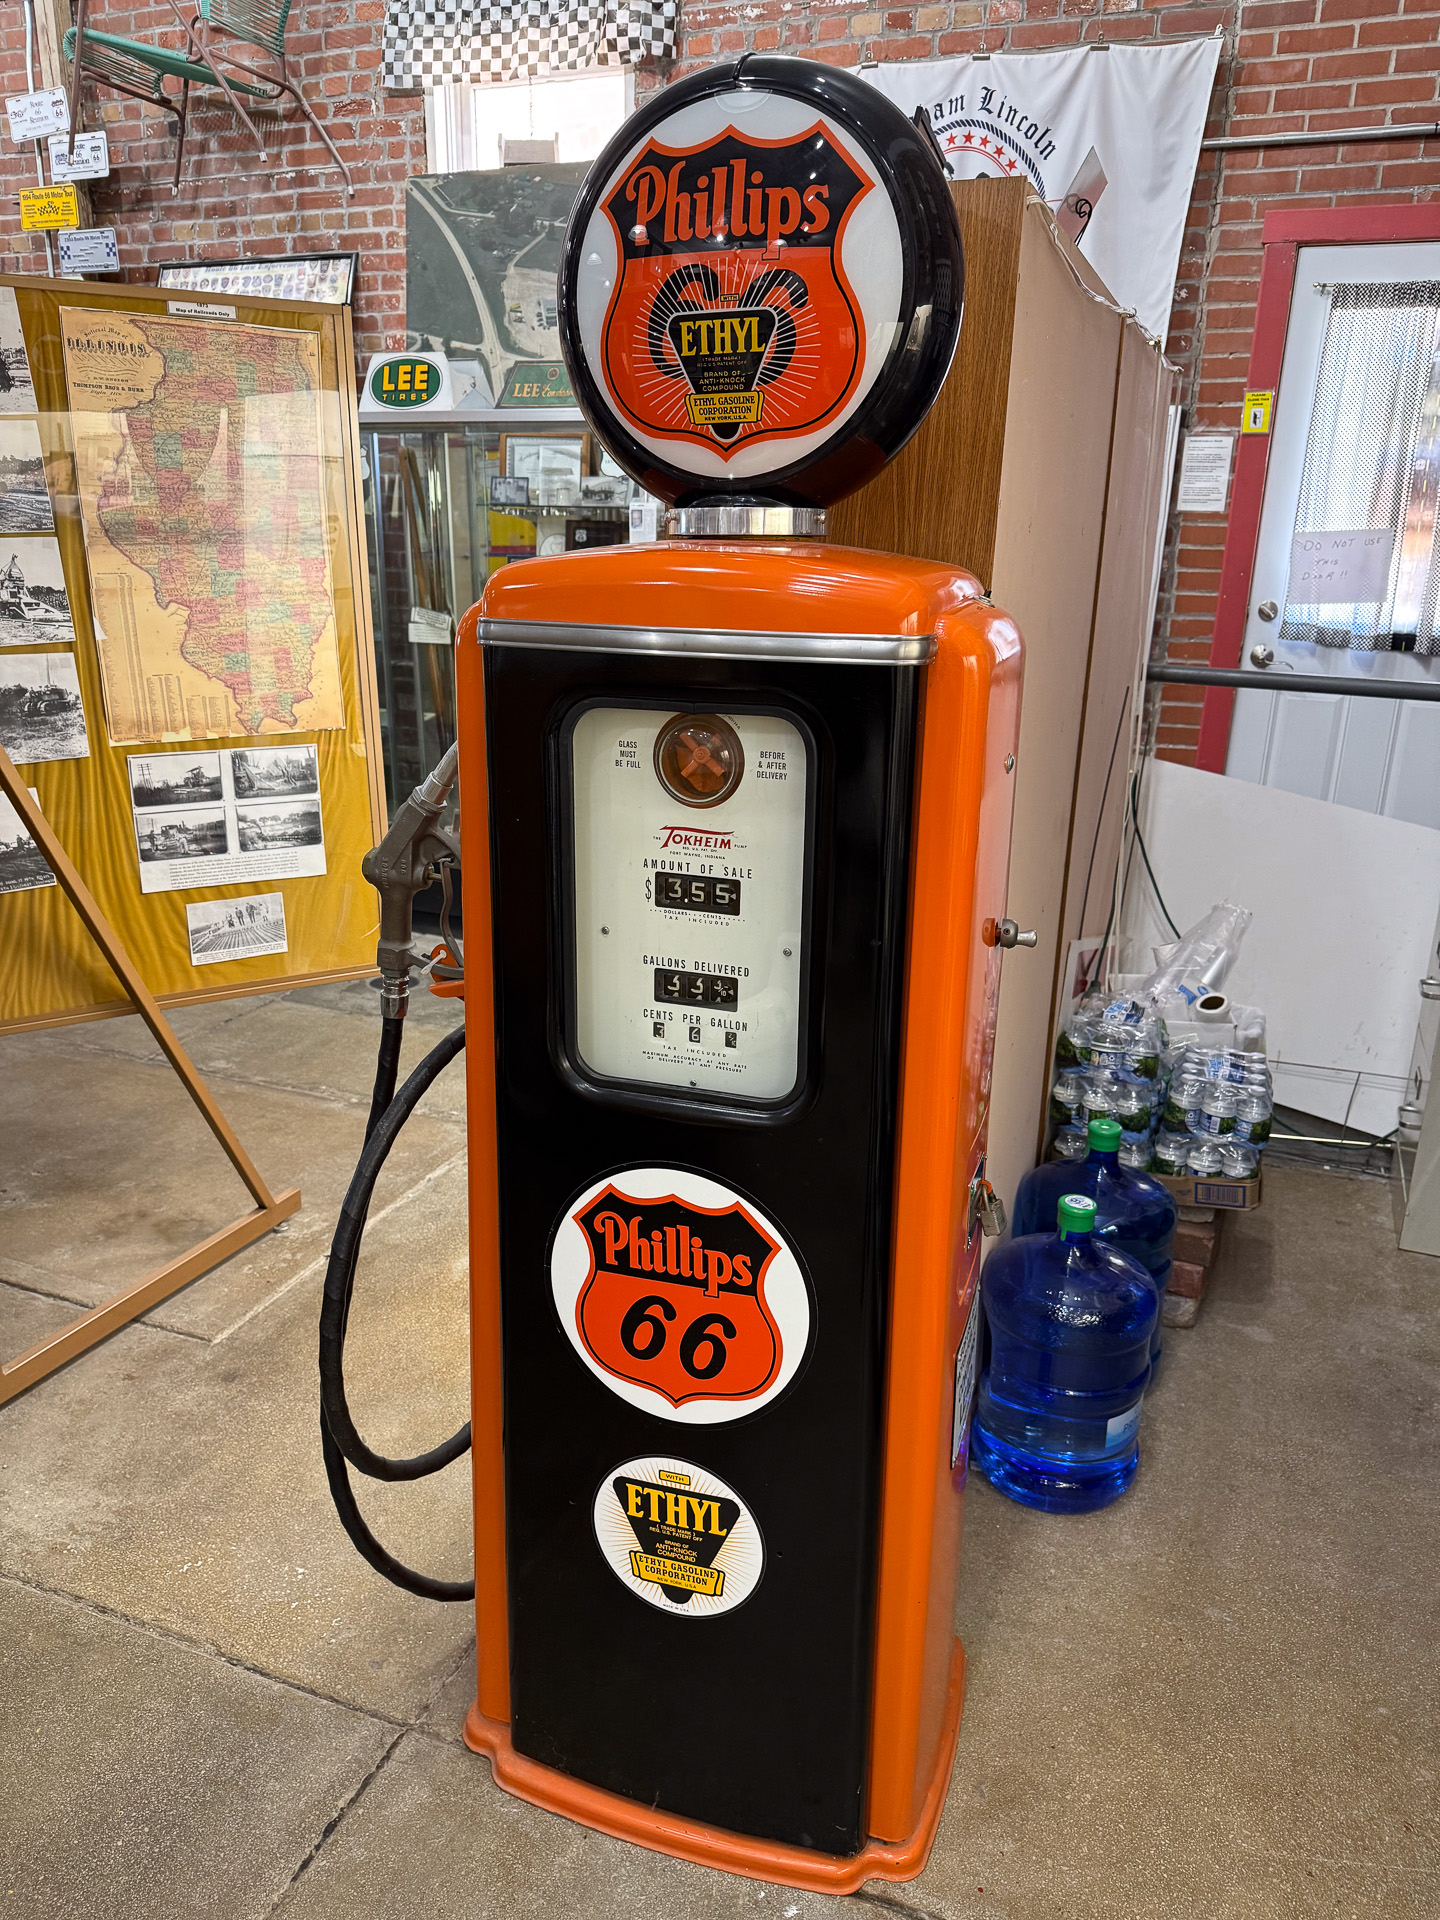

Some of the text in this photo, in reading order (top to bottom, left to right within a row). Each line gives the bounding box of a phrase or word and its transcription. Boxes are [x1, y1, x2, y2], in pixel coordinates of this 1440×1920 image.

[978, 86, 1056, 160] Lincoln
[626, 158, 830, 260] Phillips
[193, 308, 218, 316] Railroads
[679, 317, 765, 357] ETHYL
[67, 336, 150, 357] ILLINOIS
[382, 364, 428, 391] LEE
[699, 377, 746, 385] ANTI-KNOCK
[512, 383, 541, 397] LEE
[702, 384, 744, 392] COMPOUND
[382, 393, 427, 401] TIRES
[693, 395, 756, 407] ETHYL GASOLINE
[698, 406, 752, 416] CORPORATION
[1304, 537, 1383, 551] DO NOT USE
[1315, 558, 1339, 566] THIS
[618, 740, 638, 748] GLASS
[620, 750, 636, 758] MUST
[760, 751, 785, 760] BEFORE
[627, 760, 641, 768] FULL
[767, 762, 786, 770] AFTER
[756, 771, 787, 780] DELIVERY
[659, 825, 735, 849] TOKHEIM
[643, 858, 752, 879] AMOUNT OF SALE
[645, 877, 652, 903] $
[688, 917, 730, 926] INCLUDED
[643, 955, 750, 977] GALLONS DELIVERED
[643, 1008, 748, 1032] CENTS PER GALLON
[687, 1048, 727, 1058] INCLUDED
[716, 1065, 742, 1073] PRESSURE
[593, 1210, 753, 1298] Phillips
[620, 1295, 737, 1380] 66
[665, 1474, 684, 1482] WITH
[625, 1483, 727, 1536] ETHYL
[672, 1532, 691, 1540] PATENT
[655, 1543, 698, 1557] ANTI-KNOCK
[664, 1540, 681, 1548] BRAND
[657, 1549, 696, 1563] COMPOUND
[638, 1555, 715, 1579] ETHYL GASOLINE
[645, 1565, 708, 1586] CORPORATION
